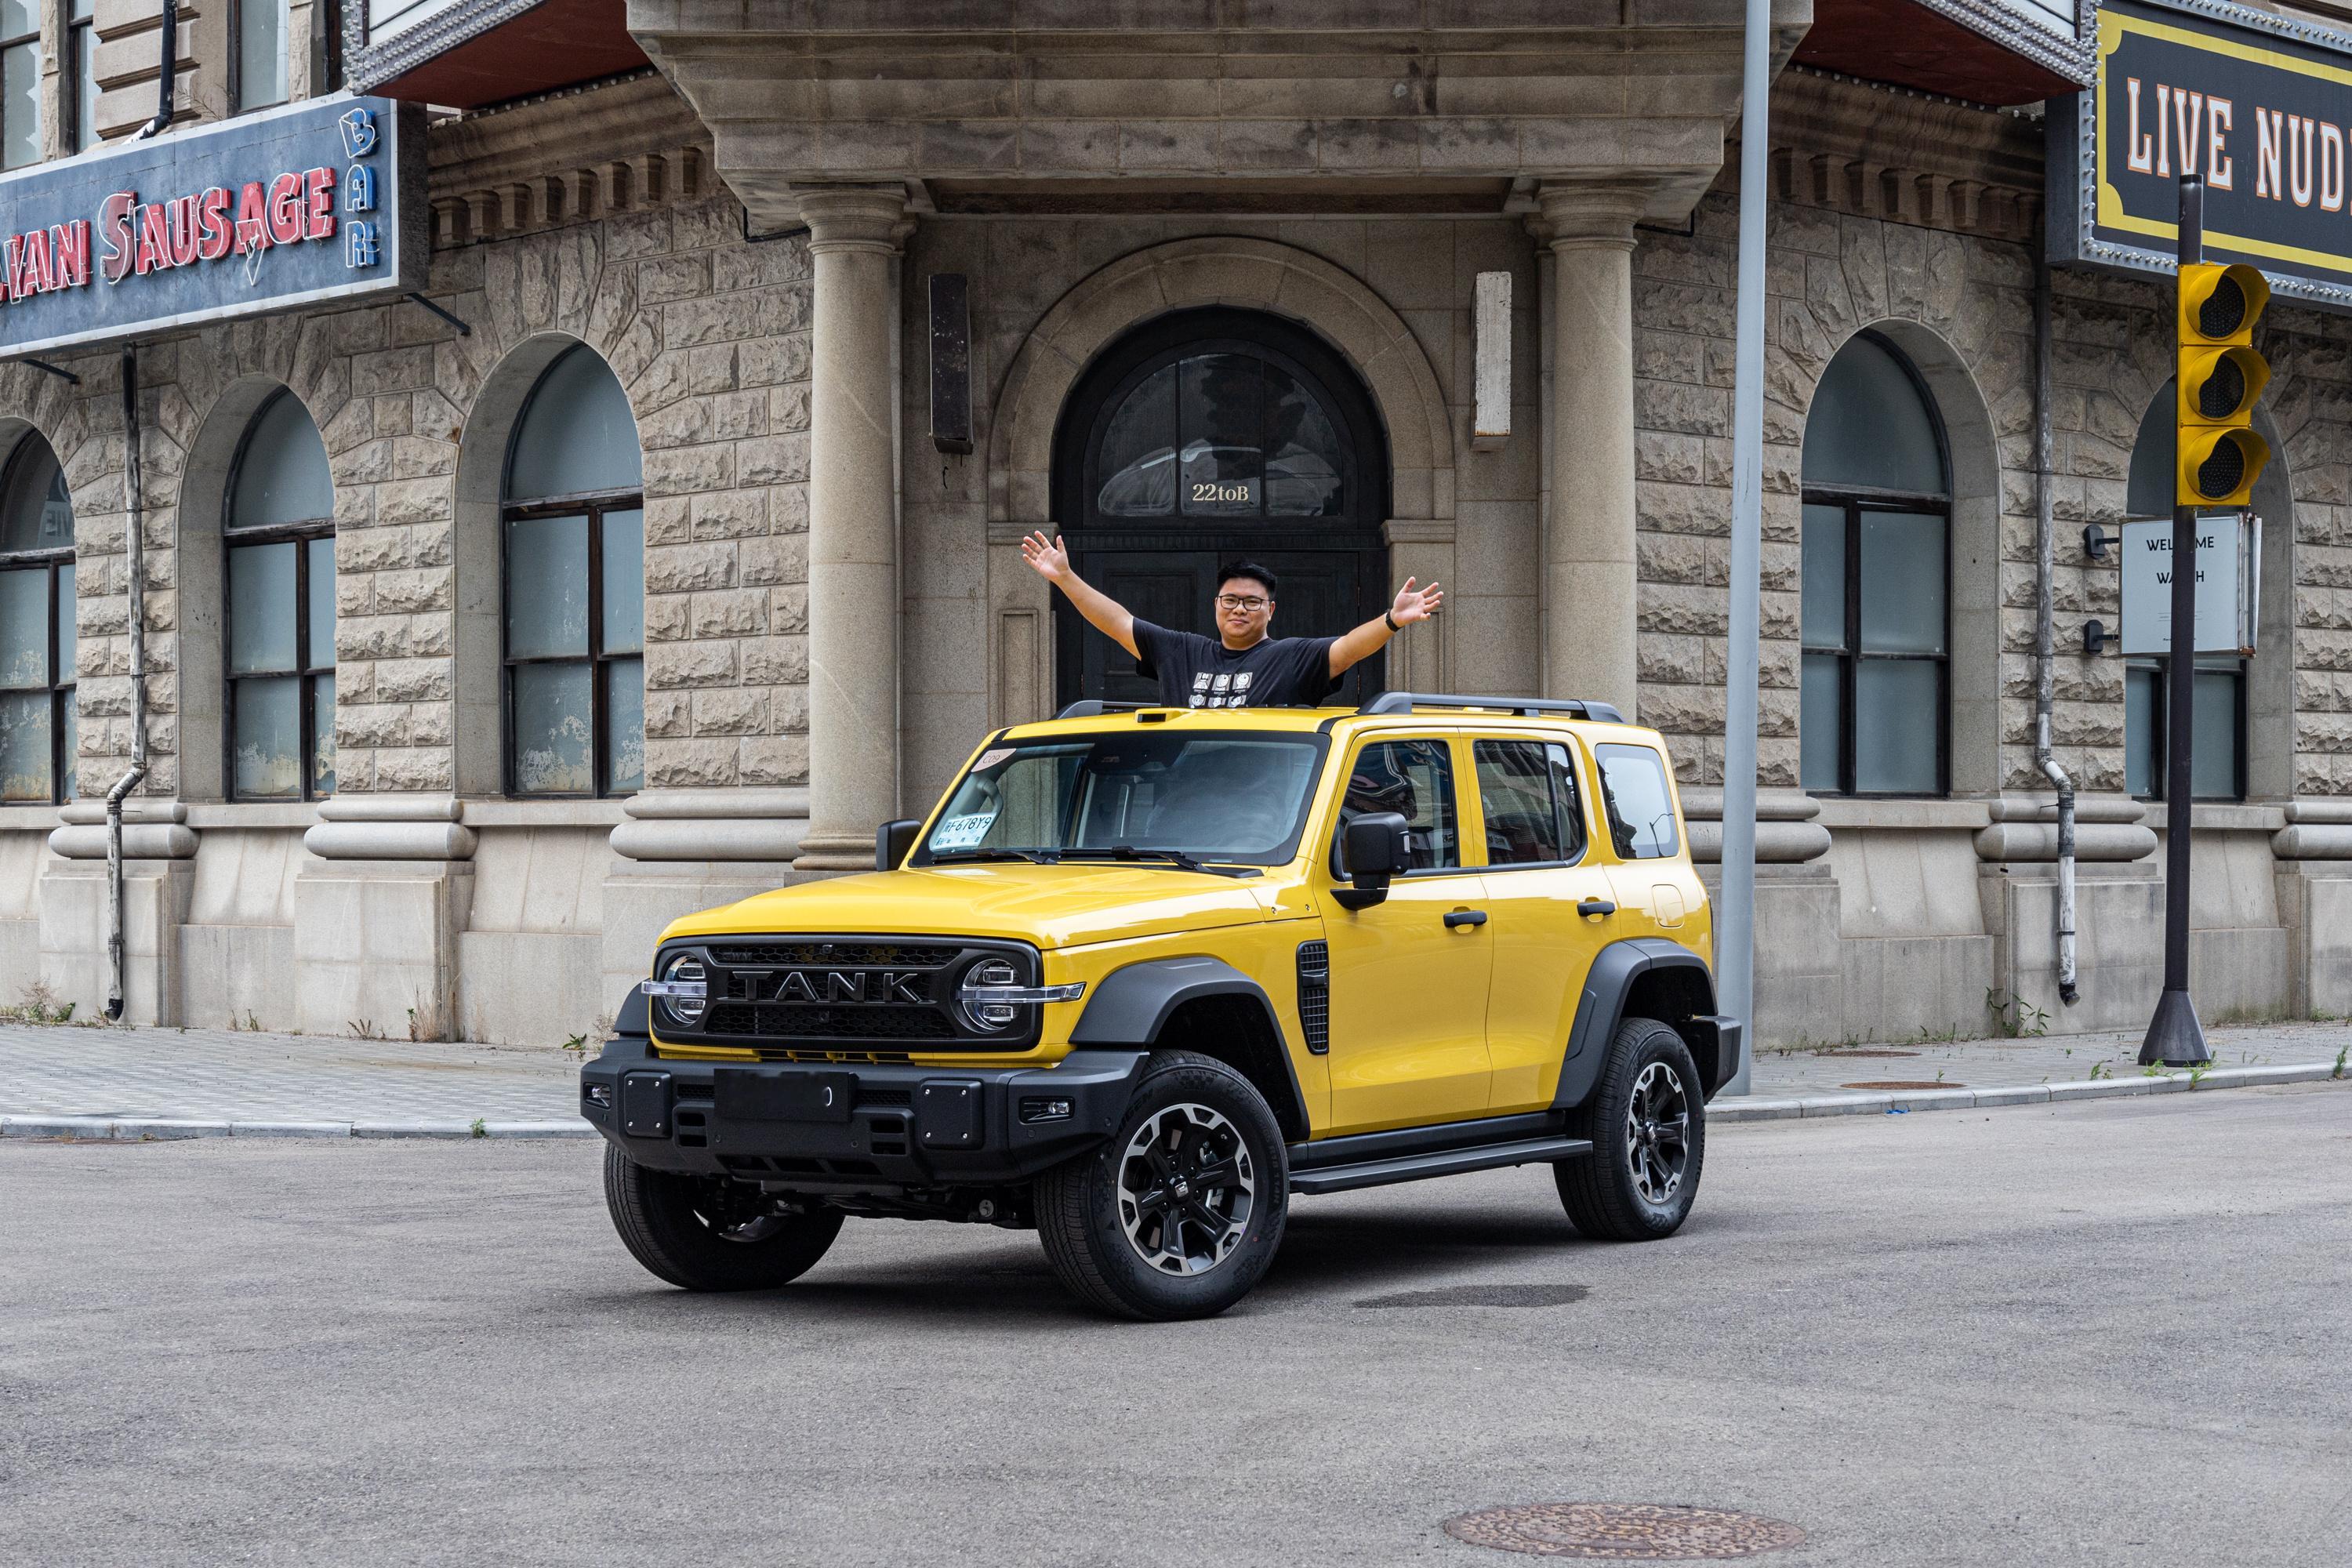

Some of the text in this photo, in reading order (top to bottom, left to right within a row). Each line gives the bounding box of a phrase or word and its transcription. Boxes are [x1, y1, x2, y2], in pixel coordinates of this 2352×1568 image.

[339, 107, 379, 268] BAR
[2127, 77, 2352, 216] LIVE NUD
[0, 166, 337, 304] IAN SAUSAGE
[1192, 484, 1249, 501] 22toB
[2146, 535, 2214, 551] WELME
[732, 971, 921, 1003] TANK
